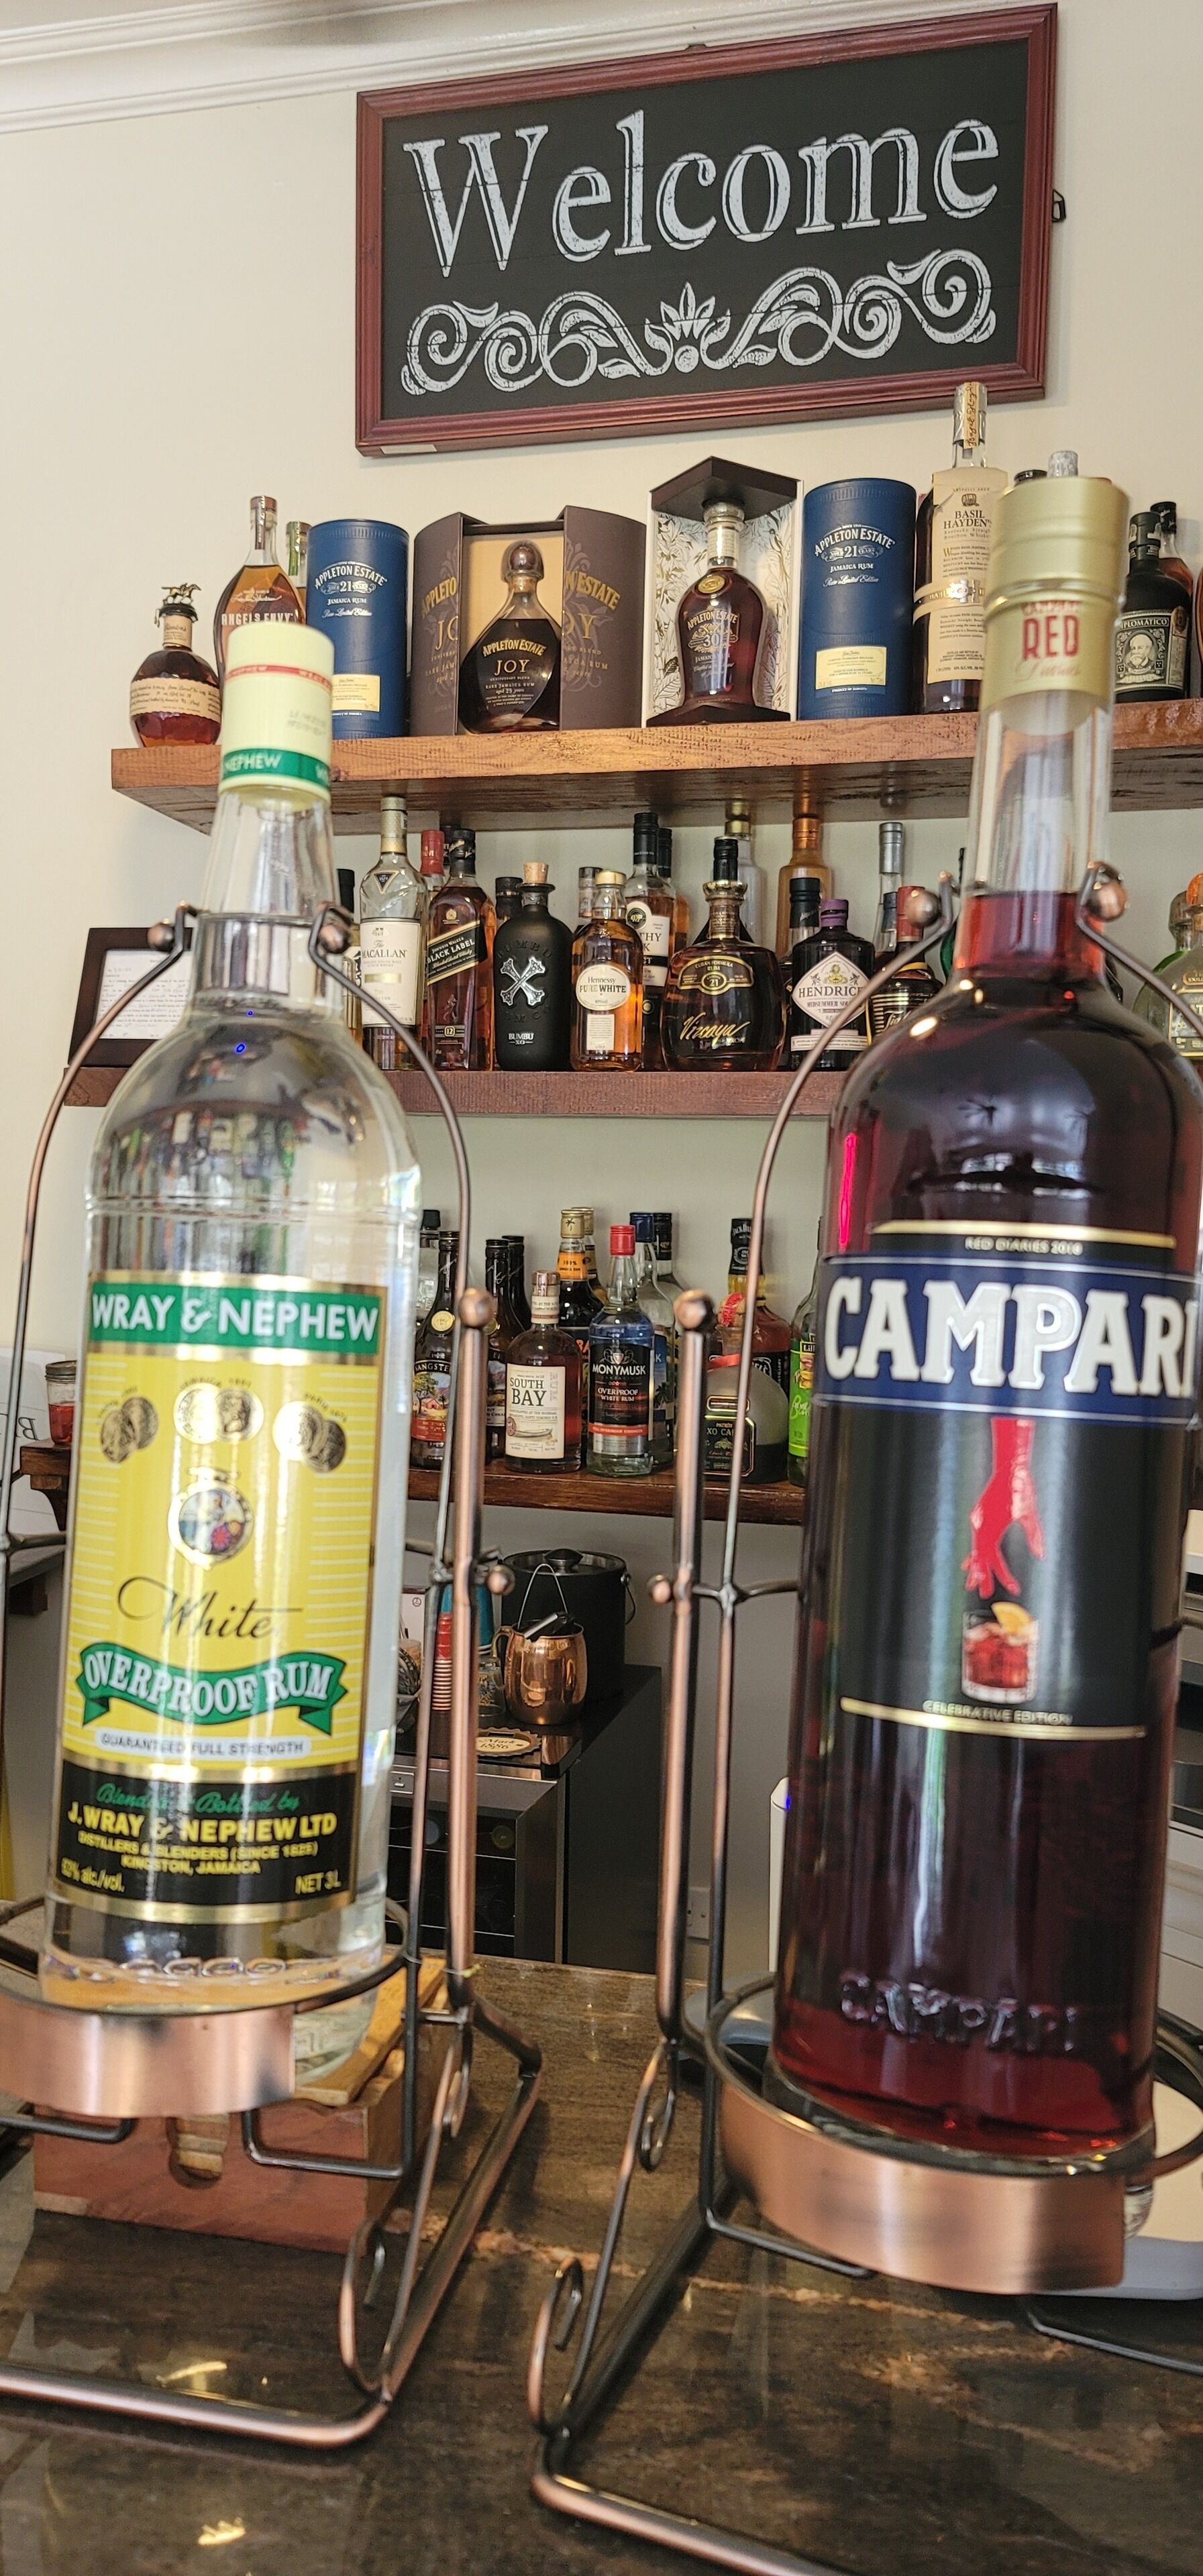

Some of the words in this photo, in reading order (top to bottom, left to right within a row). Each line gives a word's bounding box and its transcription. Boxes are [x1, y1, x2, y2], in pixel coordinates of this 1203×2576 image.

[403, 109, 1000, 278] Welcome
[955, 510, 985, 519] BASIL
[815, 528, 859, 557] APPLETON
[860, 528, 892, 549] ESTATE
[844, 545, 857, 557] 21
[315, 565, 353, 590] APPLETON
[354, 566, 384, 586] ESTATE
[830, 564, 856, 573] JAMAICA
[339, 581, 353, 592] 21
[576, 572, 621, 611] ESTATE
[687, 610, 715, 631] APPLETON
[716, 610, 738, 624] ESTATE
[702, 633, 721, 647] 30
[1021, 614, 1080, 661] RED
[482, 639, 519, 657] APPLETON
[519, 639, 547, 656] ESTATE
[494, 659, 530, 676] JOY
[362, 949, 407, 959] MACALLAN
[427, 949, 450, 964] BLACK
[451, 938, 476, 953] LABEL
[694, 961, 711, 969] CUBAN
[711, 960, 733, 968] FORMULA
[579, 985, 598, 993] PURE
[599, 984, 627, 993] WHITE
[588, 977, 617, 985] Hennessy
[709, 979, 719, 987] 21
[798, 985, 857, 999] HENDRIC
[508, 1032, 535, 1041] BUMBU
[964, 1236, 994, 1252] RED
[996, 1238, 1049, 1254] DIARIES
[92, 1293, 176, 1332] WRAY
[180, 1295, 212, 1333] &
[218, 1299, 379, 1342] NEPHEW
[415, 1362, 450, 1373] SANGSTE
[592, 1363, 647, 1376] MONYMUSK
[510, 1377, 544, 1390] SOUTH
[597, 1387, 639, 1395] OVERPROOF
[511, 1387, 547, 1407] BAY
[707, 1428, 718, 1436] XO
[117, 1576, 303, 1640] White
[85, 1650, 258, 1717] OVERPROOF
[265, 1660, 335, 1703] RUM
[923, 1700, 1012, 1723] CELEBRATIVE
[1013, 1710, 1073, 1725] EDITION
[101, 1732, 186, 1754] GUARANTEED
[191, 1741, 224, 1756] FULL
[228, 1741, 304, 1756] STRENGTH
[149, 1817, 174, 1840] &
[178, 1816, 298, 1843] NEPHEW
[299, 1812, 337, 1839] LTD
[77, 1829, 140, 1856] DISTILLERS
[155, 1845, 229, 1861] BLENDERS
[229, 1845, 280, 1861] (SINCE
[120, 1854, 194, 1877] KINGSTON,
[195, 1860, 262, 1875] JAMAICA
[295, 1872, 325, 1895] NET
